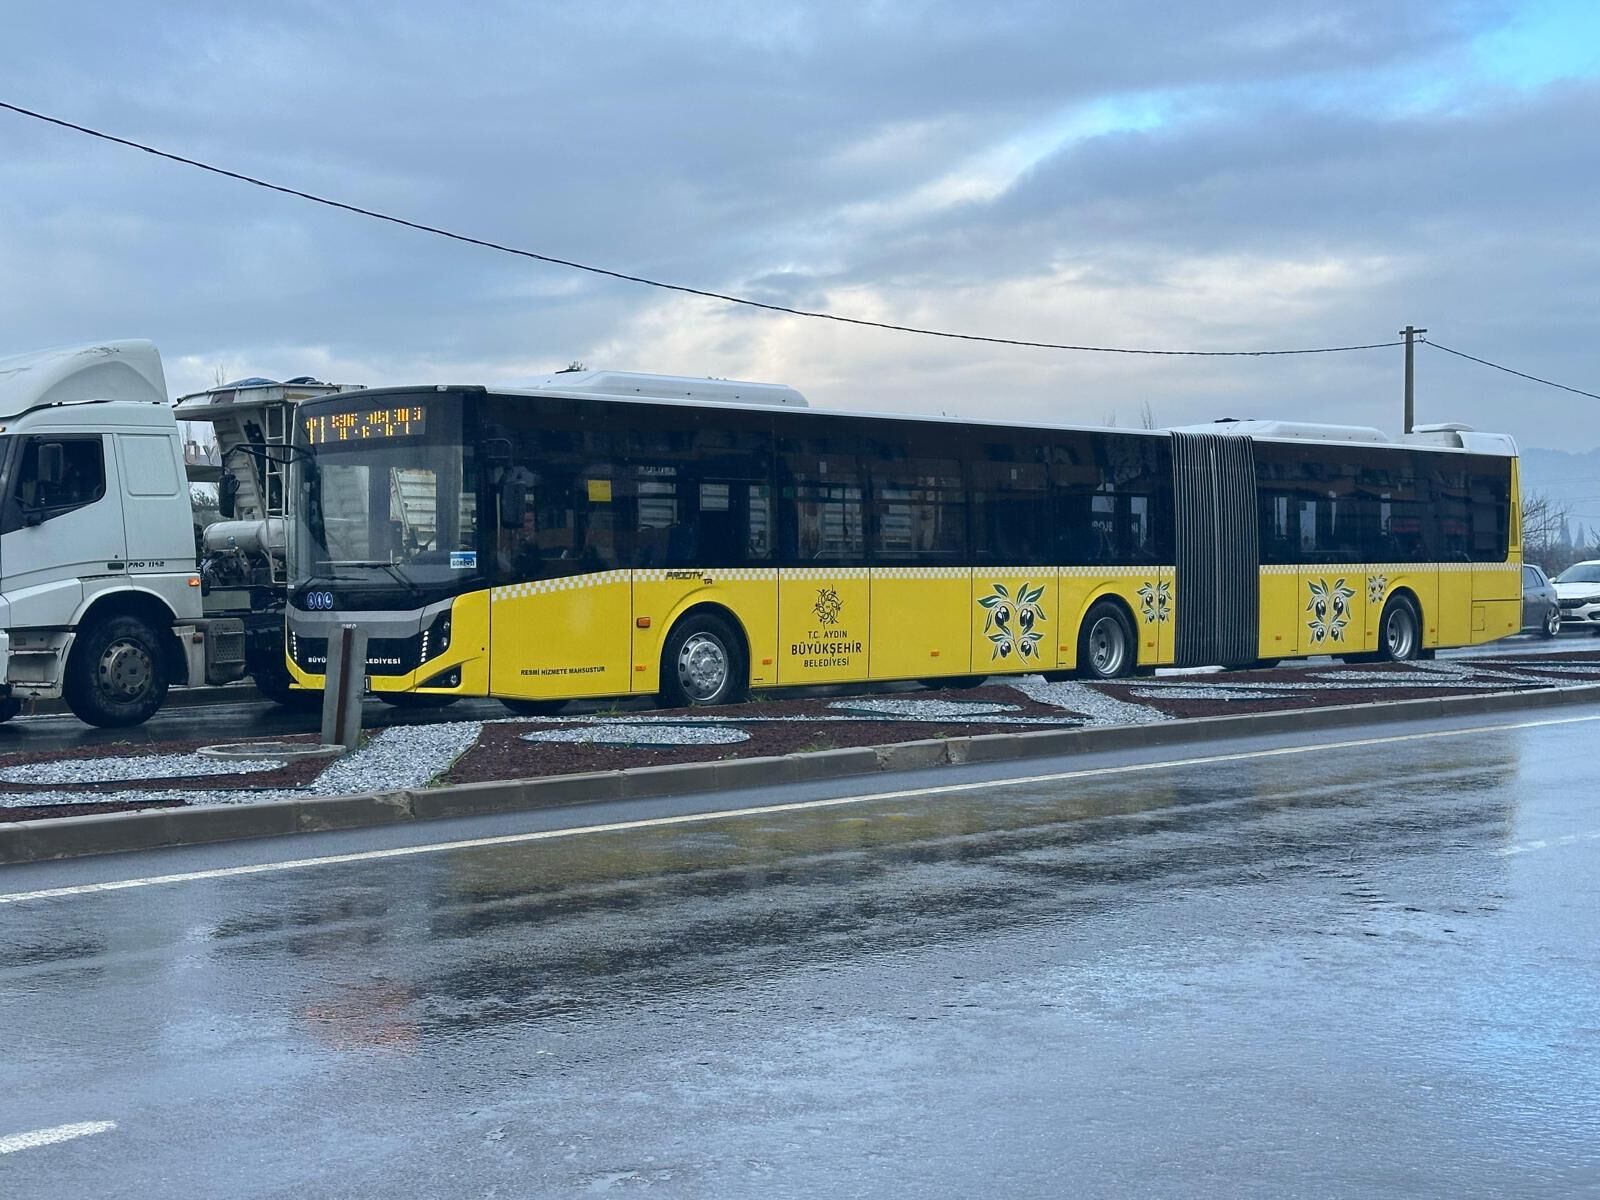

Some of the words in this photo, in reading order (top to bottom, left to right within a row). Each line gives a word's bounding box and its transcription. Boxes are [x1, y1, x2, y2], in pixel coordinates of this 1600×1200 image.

[823, 630, 848, 639] AYDIN
[791, 640, 862, 657] BÜYÜKŞEHİR
[804, 656, 850, 668] BELEDİYESİ
[541, 668, 568, 676] HİZMETE
[568, 666, 605, 674] MAHSUSTUR
